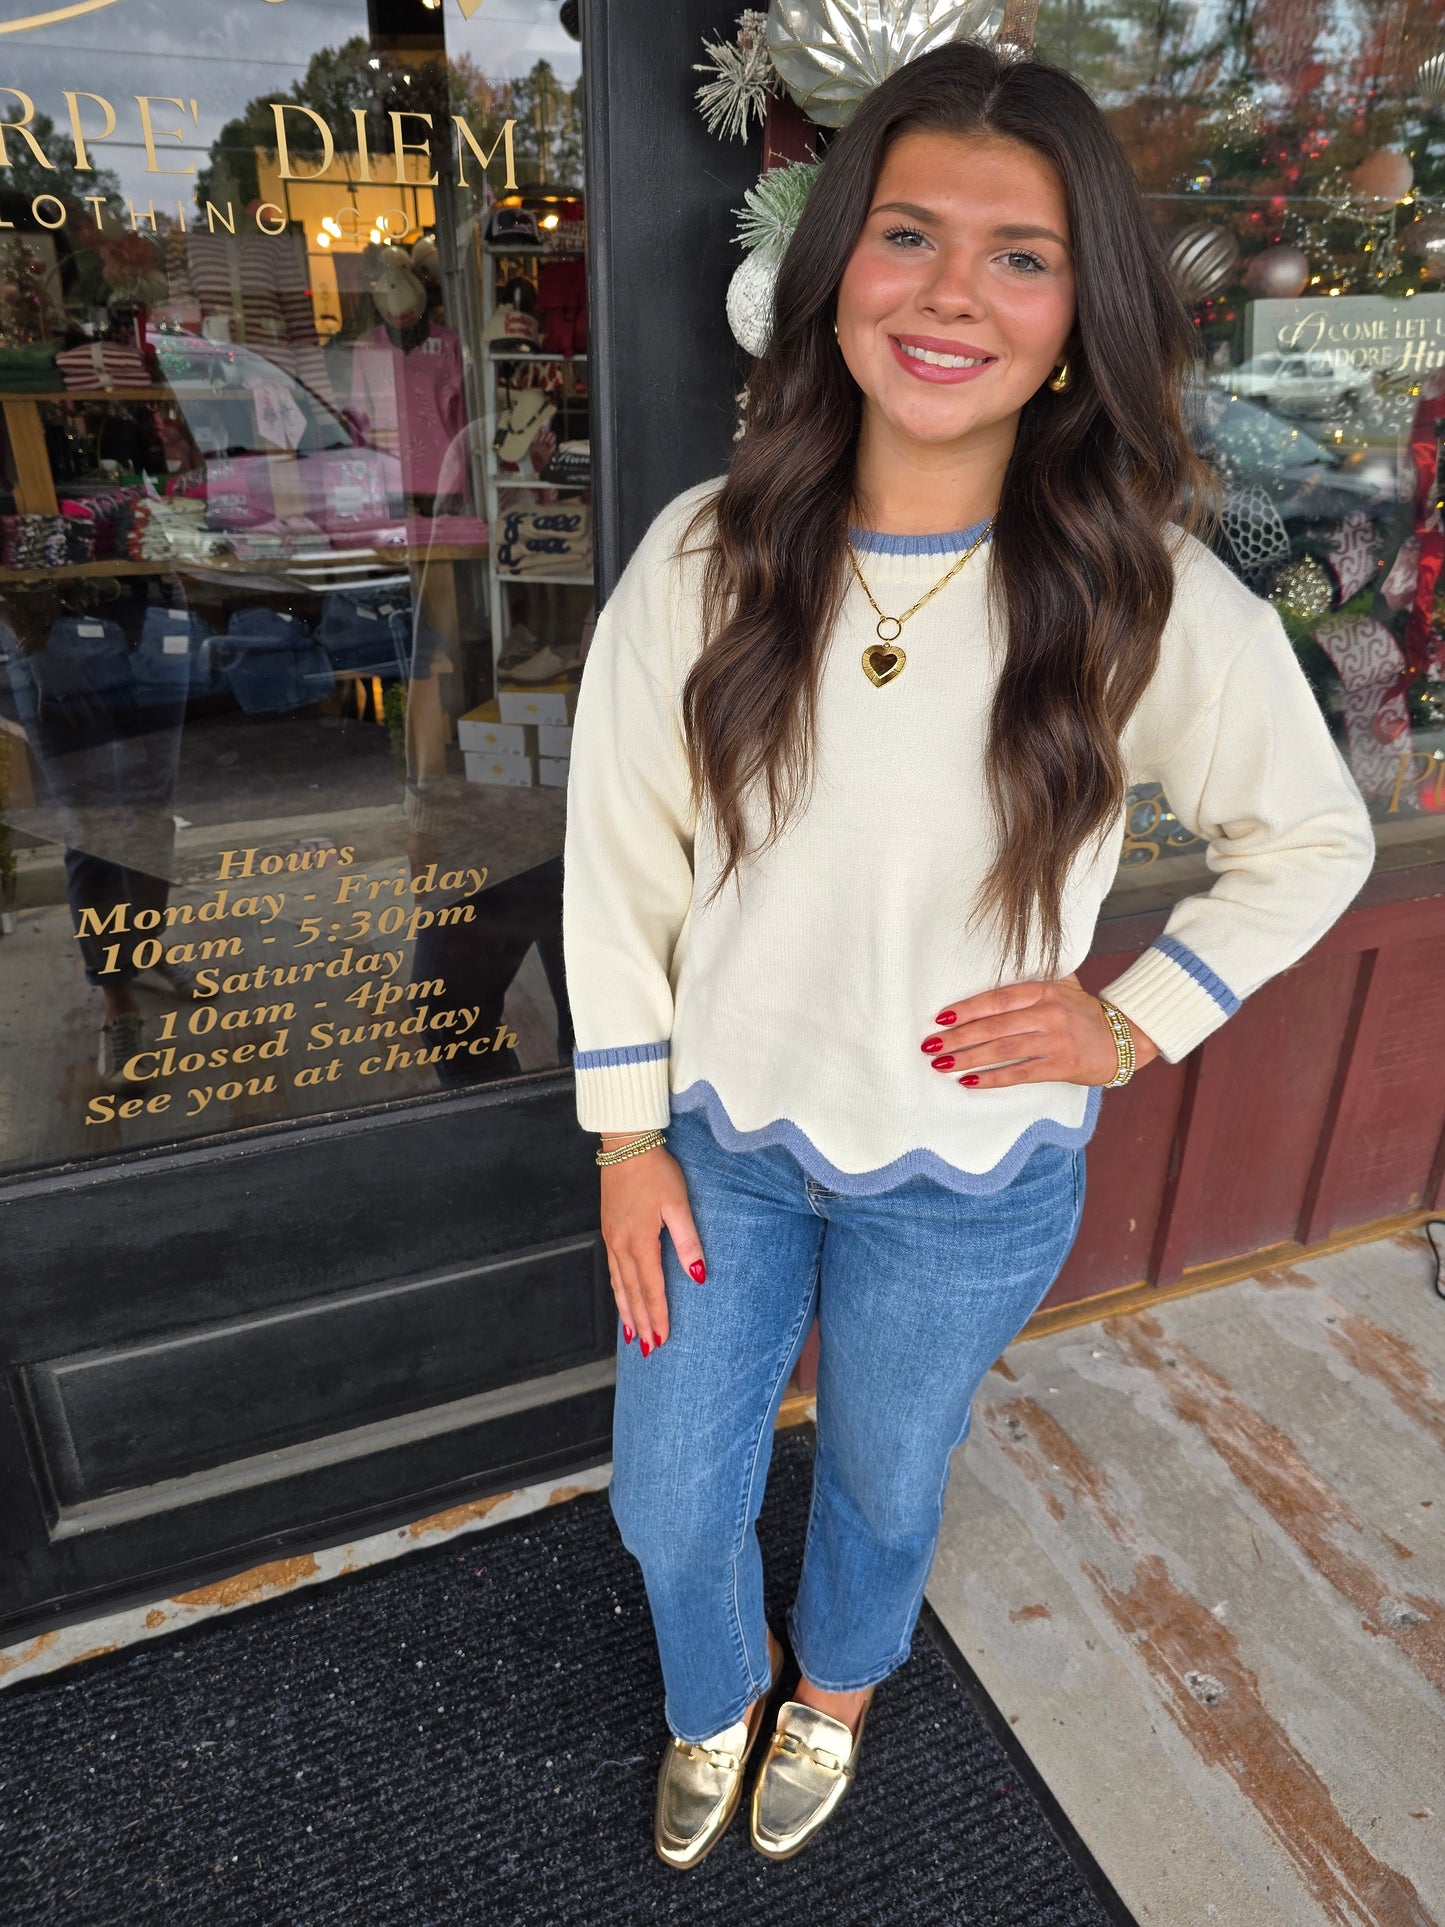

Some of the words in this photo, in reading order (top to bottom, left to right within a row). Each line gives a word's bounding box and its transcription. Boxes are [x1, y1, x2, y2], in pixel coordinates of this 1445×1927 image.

[269, 104, 518, 190] DIEM
[335, 207, 410, 239] CO
[1320, 346, 1393, 370] ADORE
[1328, 318, 1389, 342] COME
[1395, 318, 1431, 339] LET
[216, 845, 356, 881] Hours
[74, 888, 286, 940] Monday
[335, 863, 490, 906] Friday
[97, 931, 244, 975] 10am
[298, 902, 477, 949] 5:30pm
[192, 946, 405, 1000] Saturday
[154, 1002, 298, 1042] 10am
[350, 975, 446, 1017] 4pm
[84, 1092, 172, 1126] See
[186, 1075, 276, 1117] you
[292, 1060, 342, 1088] at
[357, 1024, 519, 1076] church
[121, 1029, 290, 1083] Closed
[305, 1003, 482, 1052] Sunday
